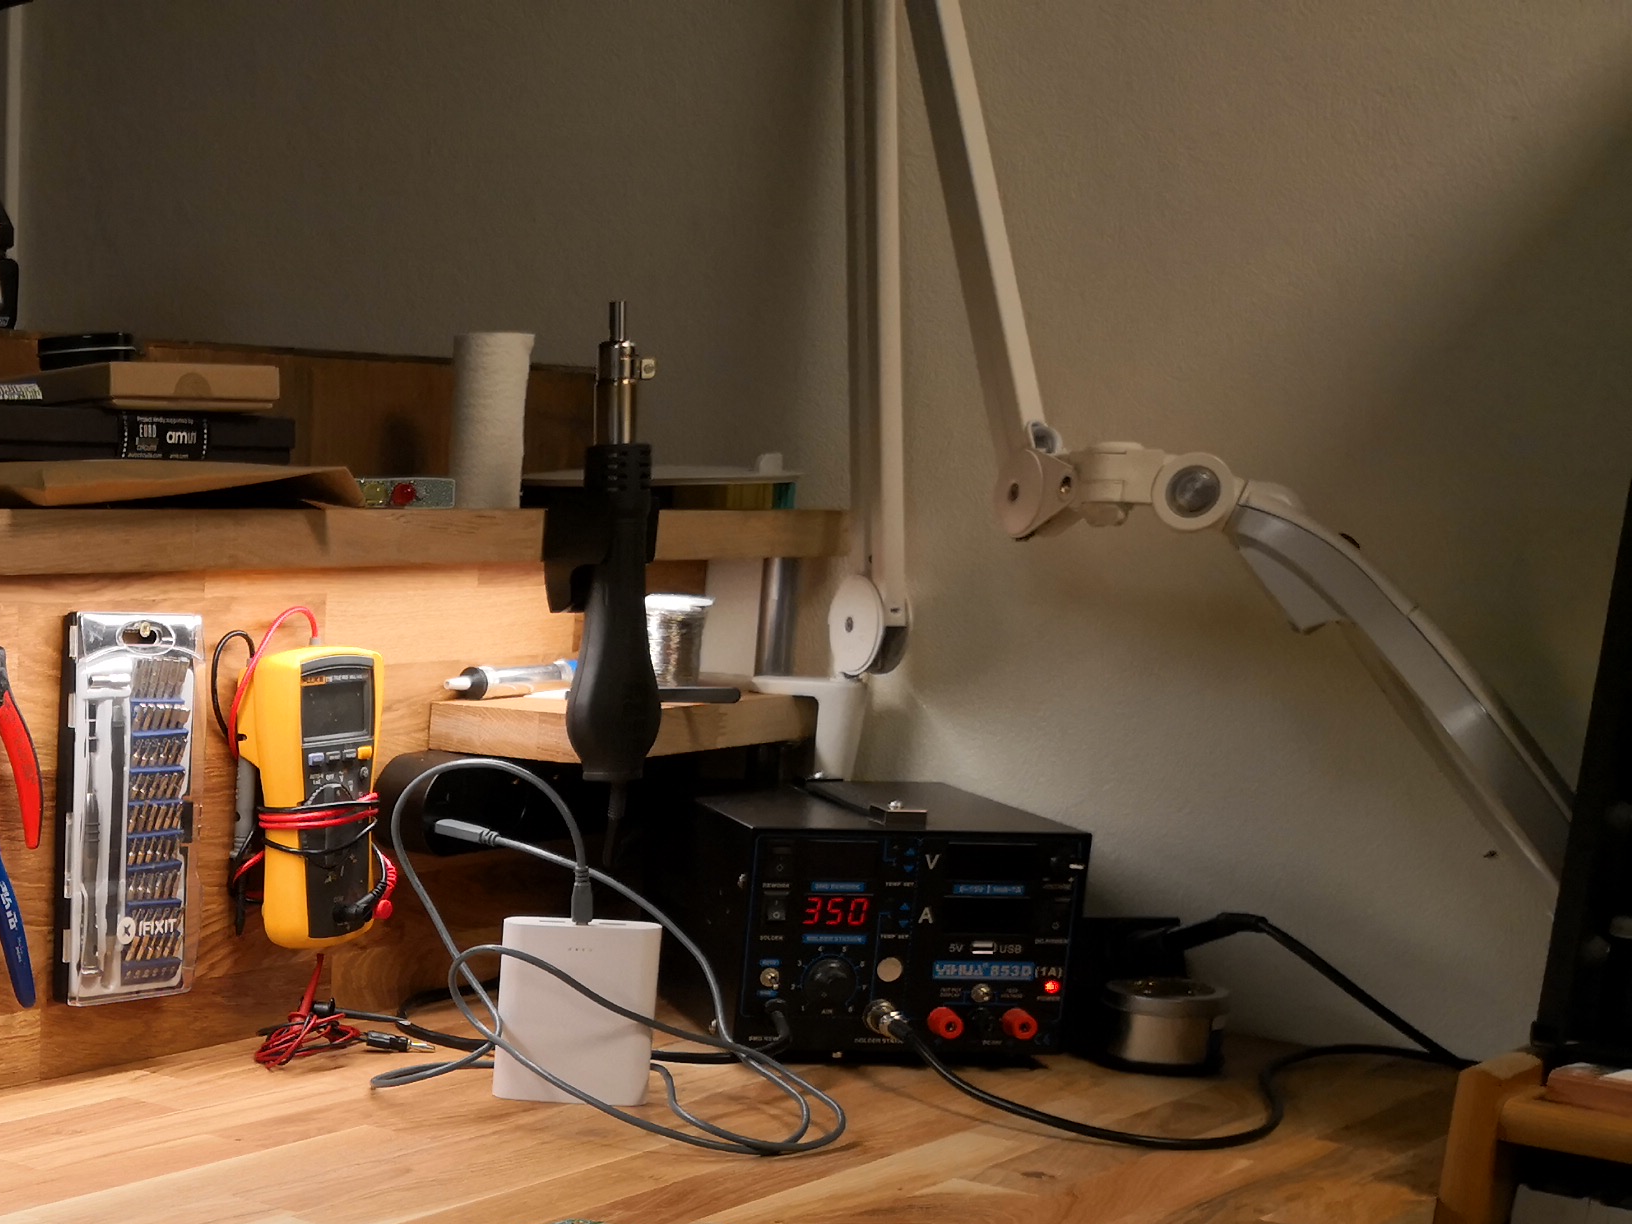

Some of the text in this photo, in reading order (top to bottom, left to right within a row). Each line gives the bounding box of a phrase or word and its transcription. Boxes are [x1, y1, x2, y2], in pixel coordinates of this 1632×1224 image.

[925, 853, 941, 870] V
[801, 895, 872, 927] 350
[918, 906, 934, 924] A
[948, 943, 1023, 954] 5V USB
[990, 964, 1033, 976] 853D
